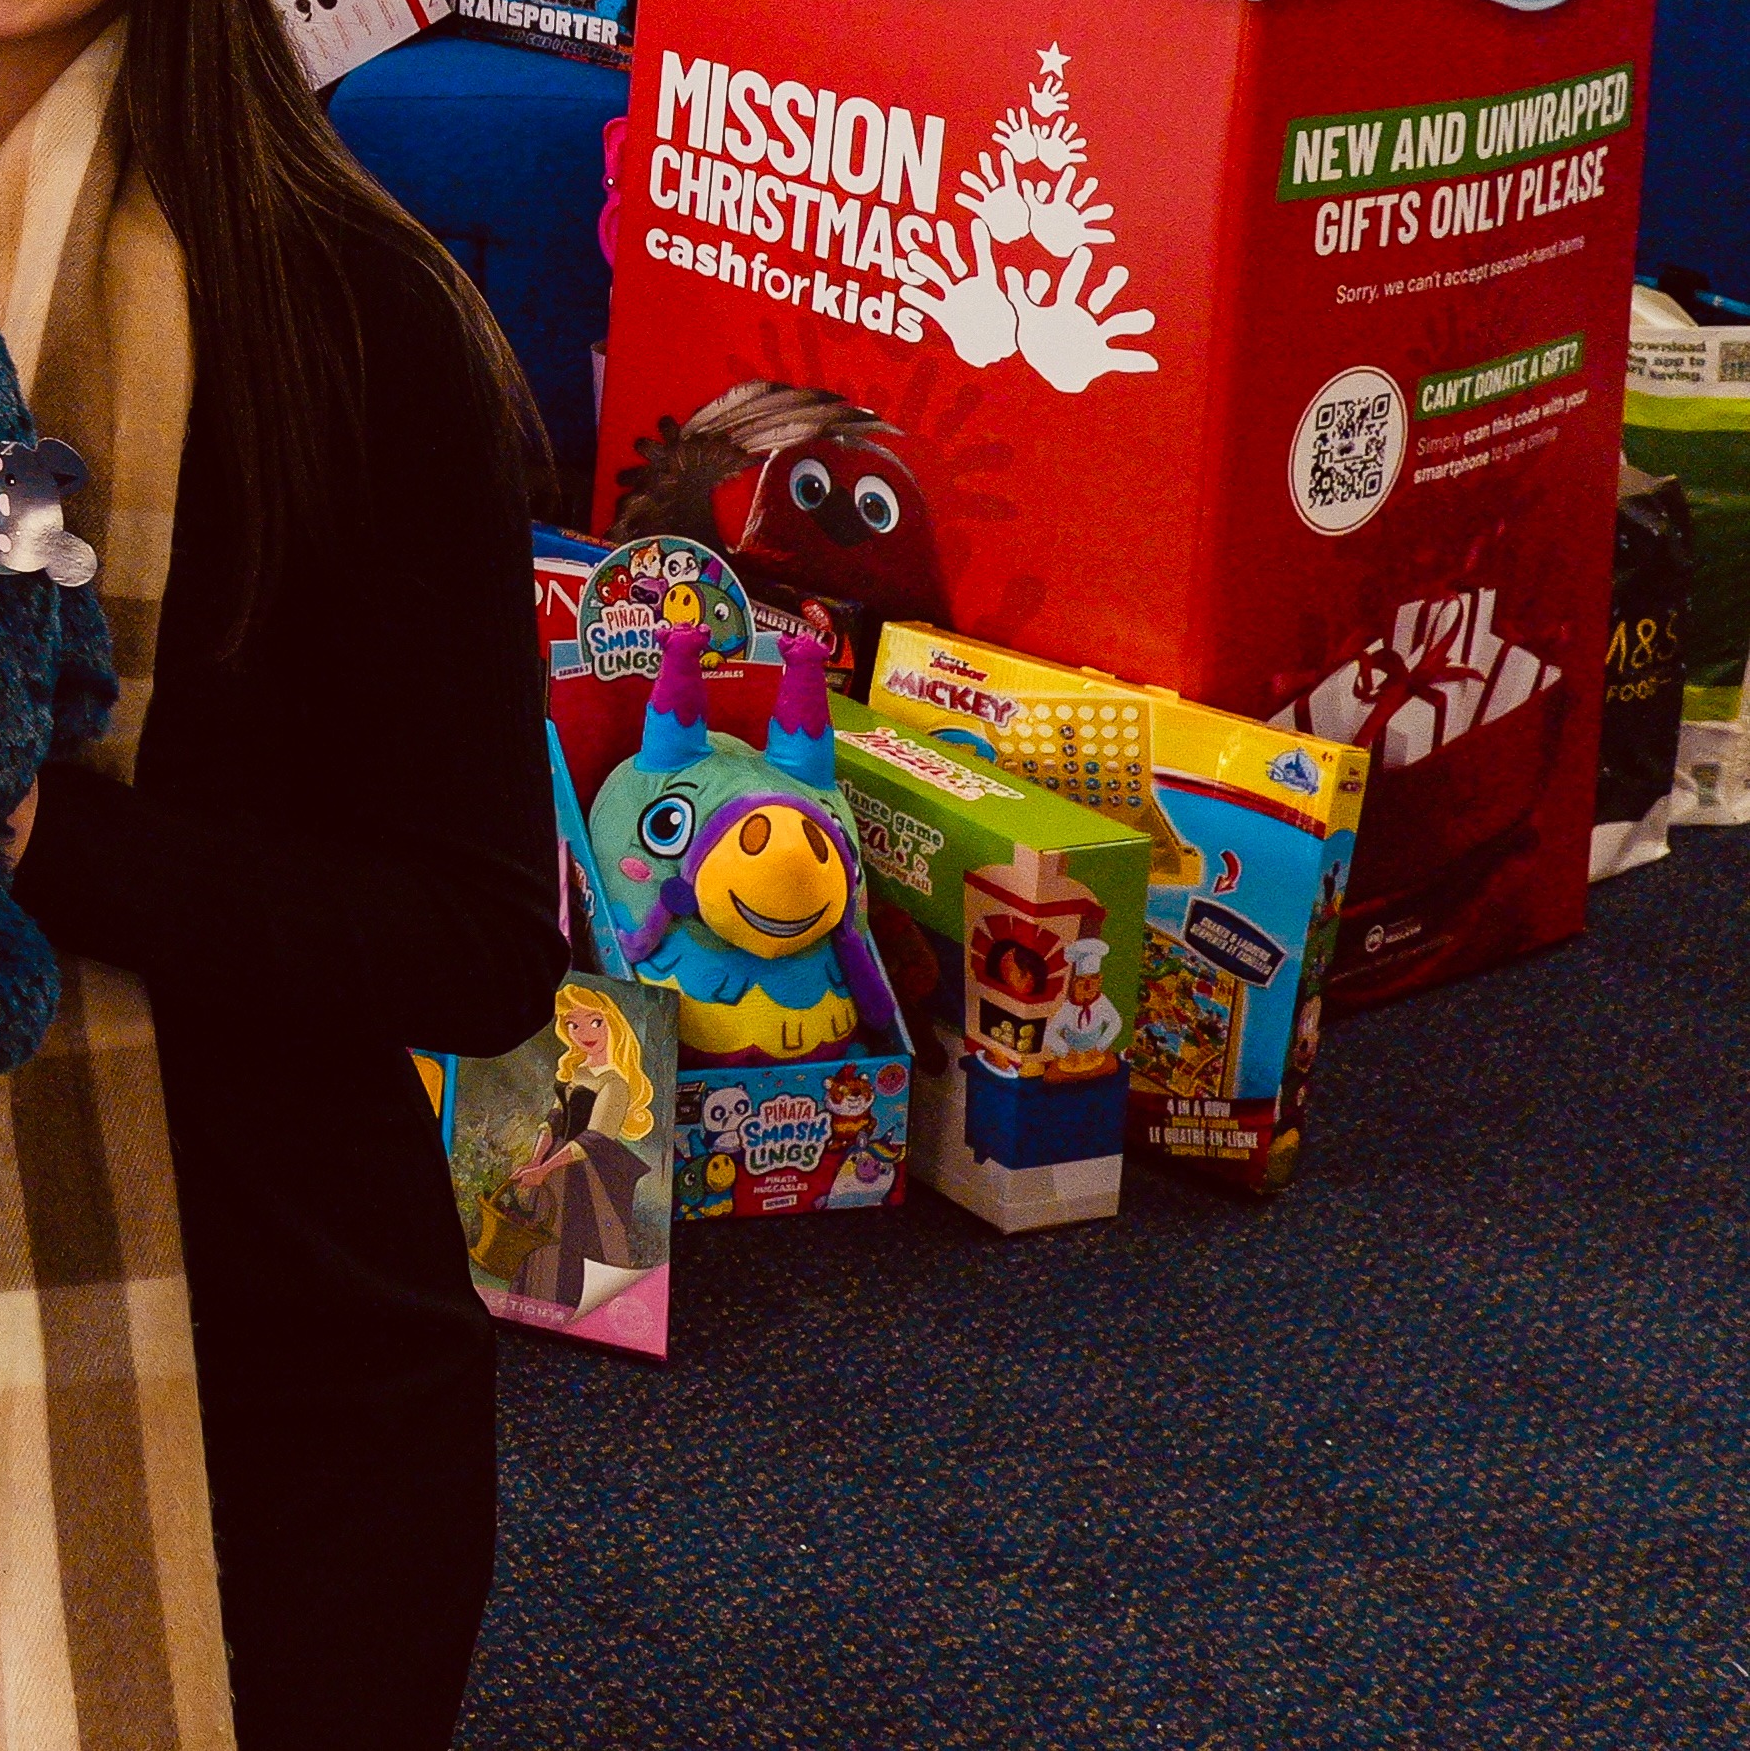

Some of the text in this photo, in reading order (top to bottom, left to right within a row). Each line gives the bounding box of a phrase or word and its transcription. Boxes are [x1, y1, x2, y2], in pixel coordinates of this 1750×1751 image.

[655, 49, 946, 215] MISSION
[1292, 71, 1629, 185] NEW AND UNWRAPPED
[648, 143, 934, 287] CHRISTMAS
[1314, 145, 1609, 256] GIFTS ONLY PLEASE
[1336, 284, 1380, 305] Sorry,
[1383, 282, 1405, 298] we
[1406, 271, 1442, 294] can't
[1443, 263, 1490, 288] accept
[1421, 341, 1580, 413] CAN'T DONATE A GIFT?
[1462, 423, 1491, 446] scan
[1492, 413, 1514, 436] this
[1513, 406, 1542, 429] code
[1413, 450, 1491, 485] smartphone
[605, 604, 651, 630] PIÑATA
[884, 668, 1019, 728] MICKEY
[763, 1098, 813, 1124] PIÑATA
[743, 1120, 829, 1148] SMASH
[748, 1144, 817, 1172] LINGS
